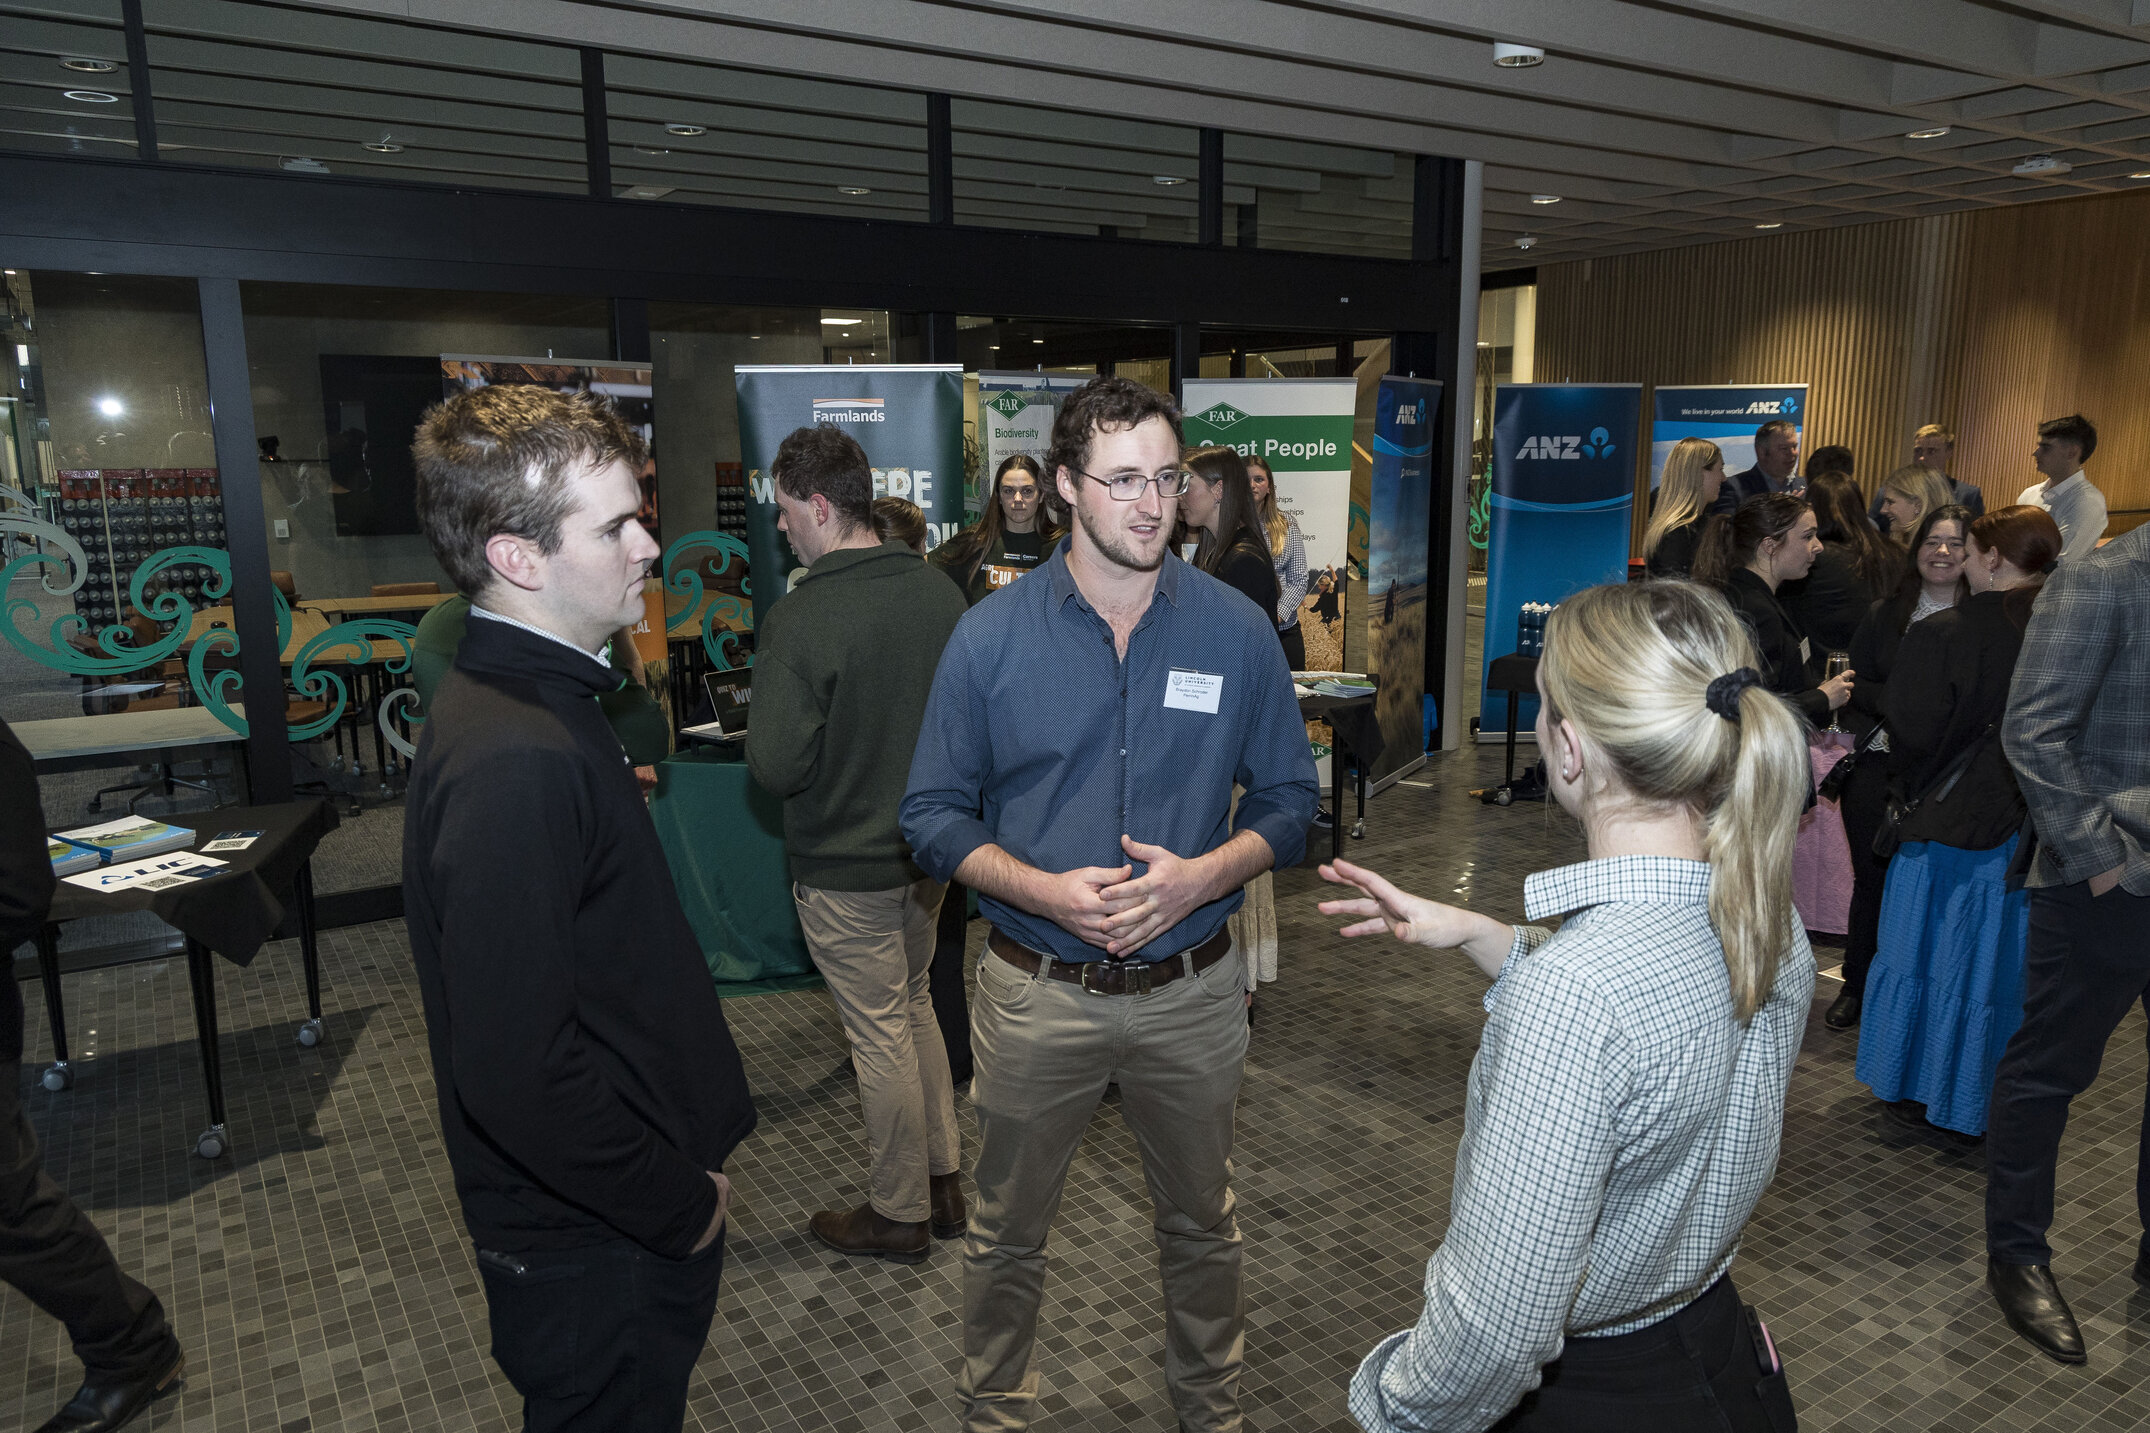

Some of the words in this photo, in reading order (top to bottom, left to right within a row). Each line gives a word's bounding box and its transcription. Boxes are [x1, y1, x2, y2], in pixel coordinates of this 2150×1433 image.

[999, 399, 1018, 411] FAR
[1745, 402, 1780, 414] ANZ
[813, 410, 885, 422] Farmlands
[1208, 410, 1236, 422] FAR
[1395, 405, 1416, 424] ANZ
[995, 428, 1039, 440] Biodiversity
[1265, 439, 1337, 460] People
[1515, 436, 1581, 459] ANZ
[133, 857, 192, 877] LIC
